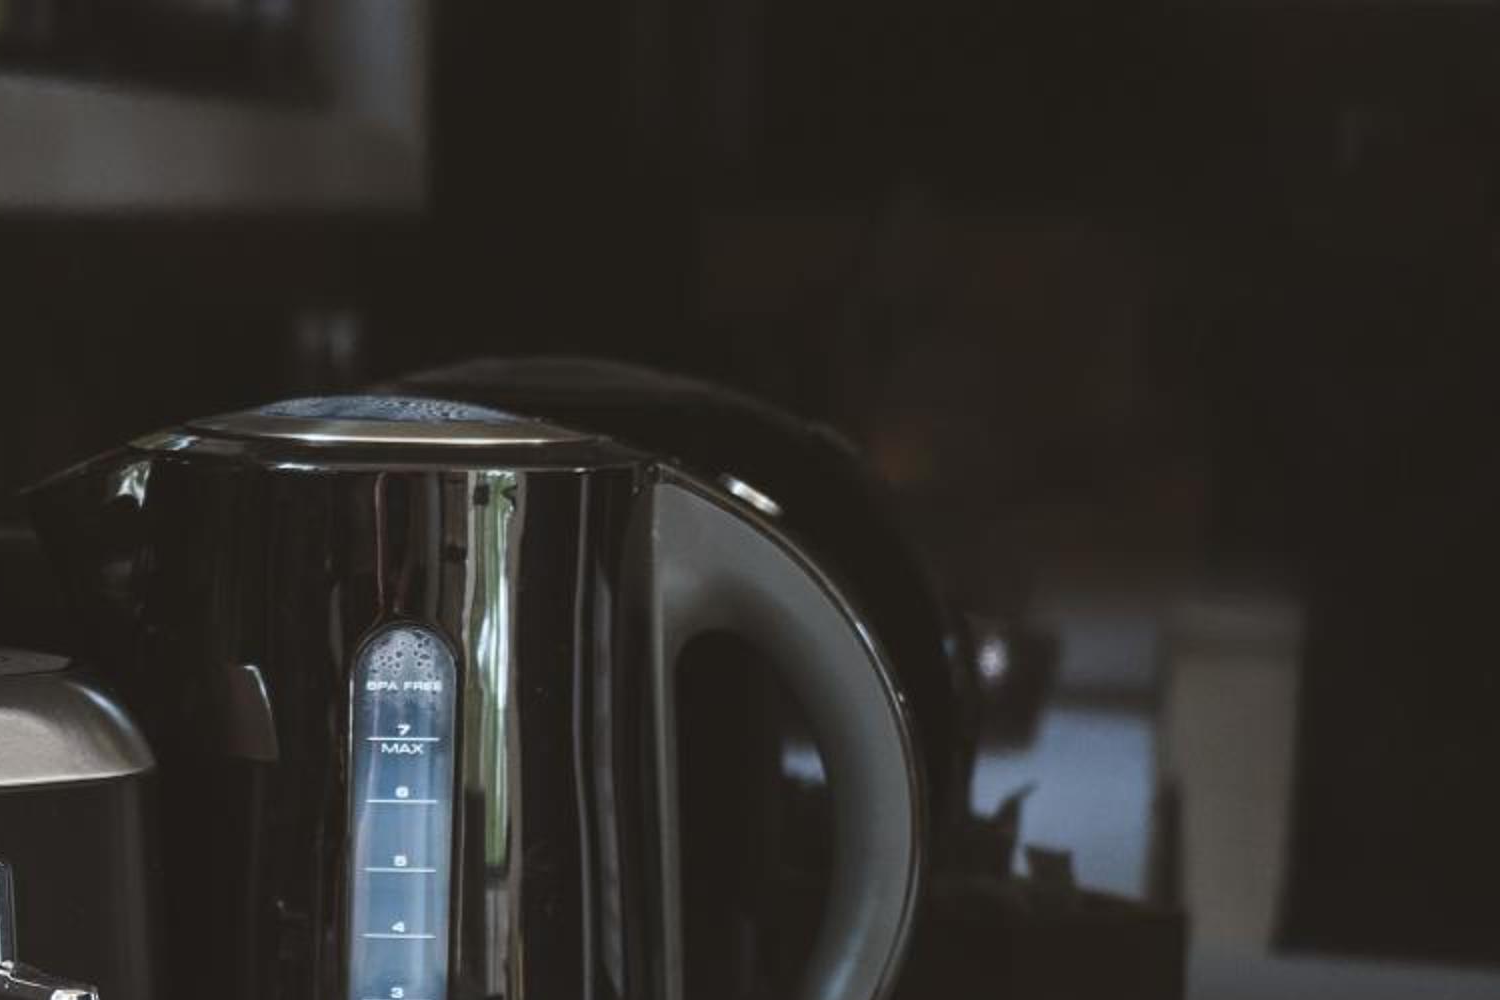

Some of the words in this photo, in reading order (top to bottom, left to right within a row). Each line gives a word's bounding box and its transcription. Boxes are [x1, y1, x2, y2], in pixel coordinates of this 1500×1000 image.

[366, 680, 399, 692] BPA
[403, 680, 443, 692] FREE
[397, 723, 411, 736] 7
[381, 743, 425, 755] MAX
[395, 786, 409, 799] 6
[391, 921, 405, 933] 4
[390, 987, 405, 999] 3
